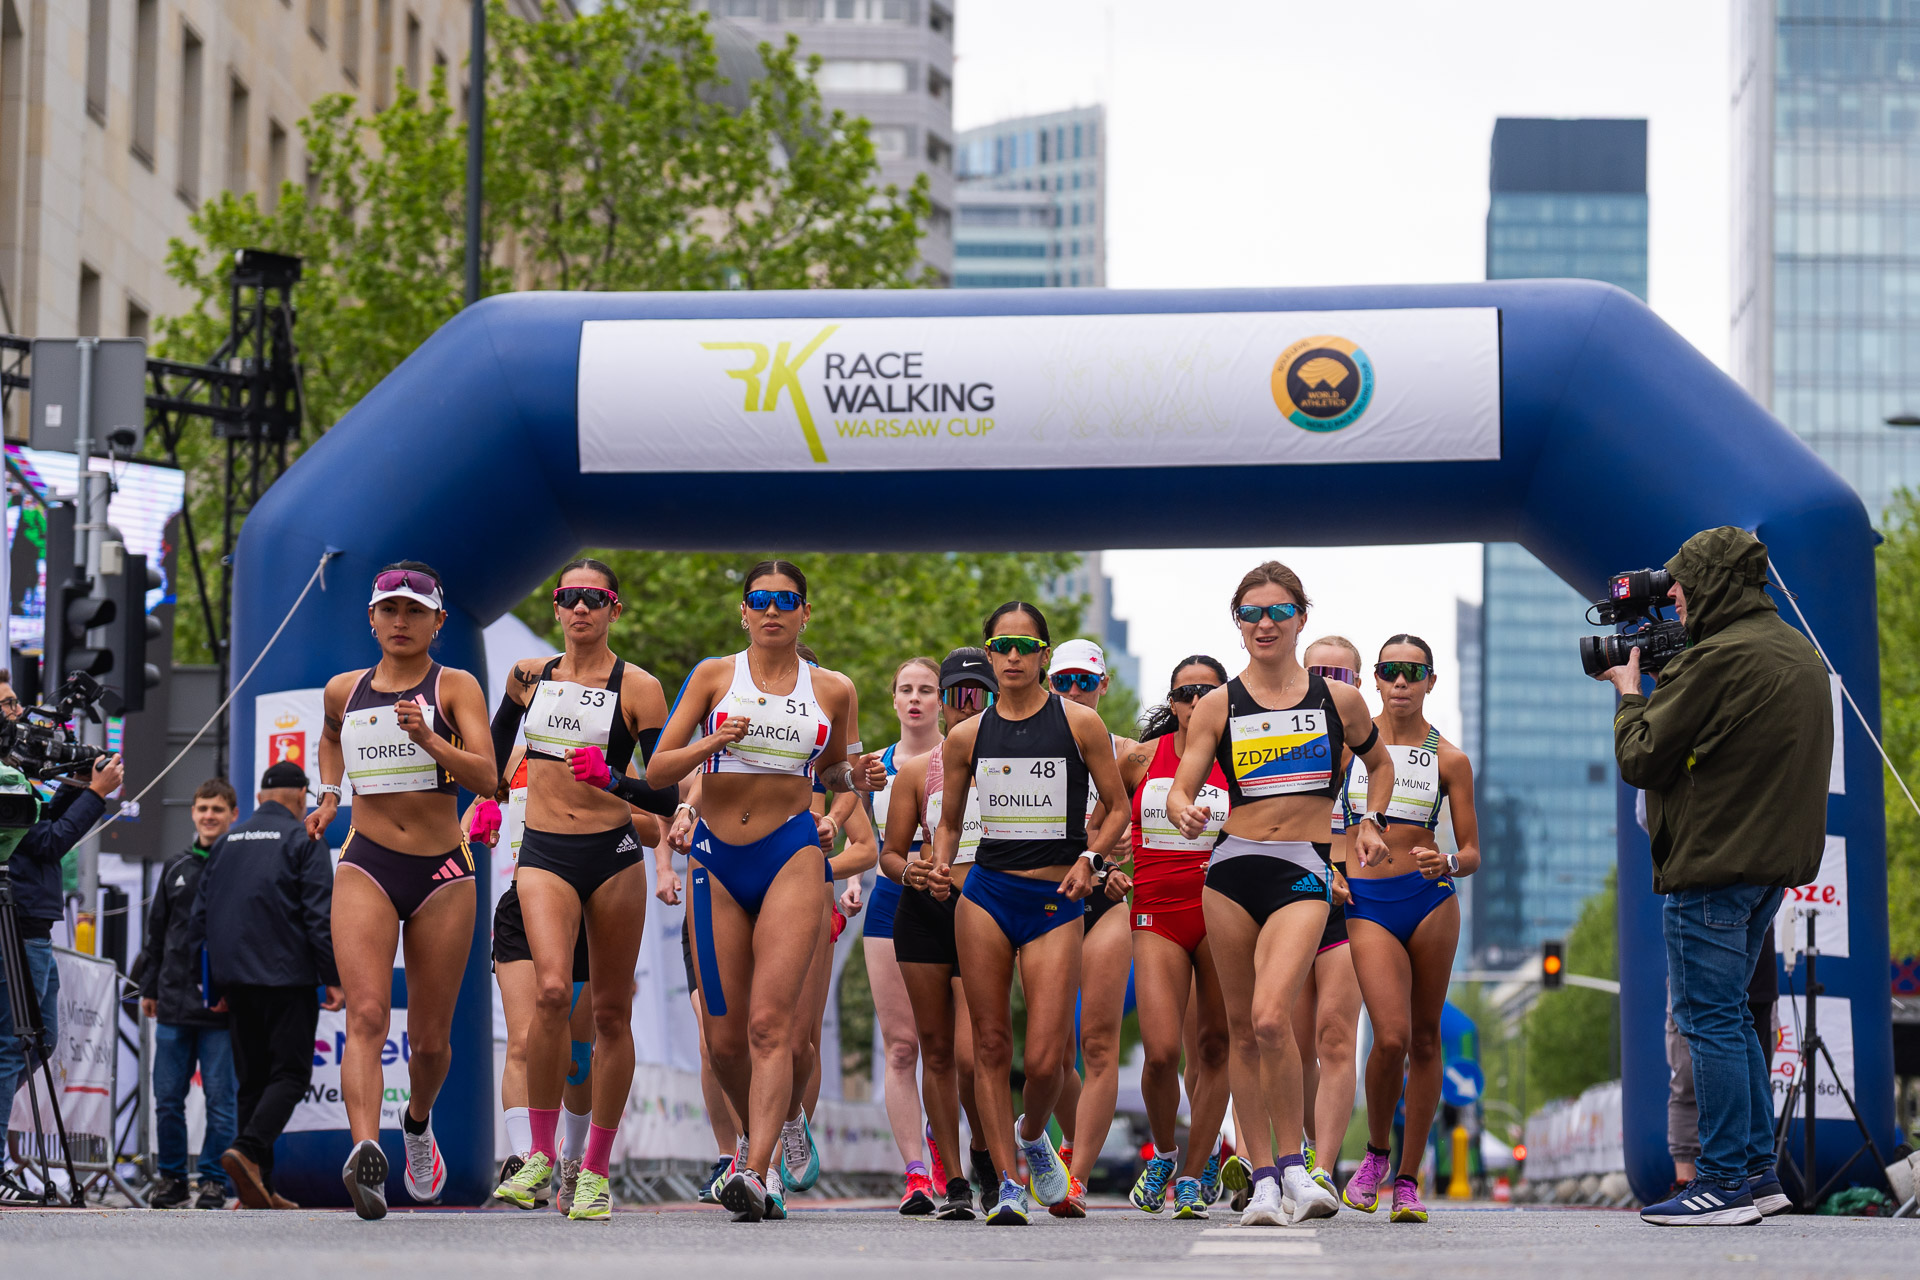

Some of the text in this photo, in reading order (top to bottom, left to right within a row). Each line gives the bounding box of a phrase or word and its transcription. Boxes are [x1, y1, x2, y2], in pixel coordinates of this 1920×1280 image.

[824, 352, 923, 379] RACE
[823, 382, 995, 413] WALKING
[1301, 399, 1347, 407] ATHLETICS
[1307, 391, 1339, 399] WORLD
[834, 418, 995, 438] WARSAW CUP
[580, 690, 606, 708] 53
[785, 698, 809, 717] 51
[548, 715, 581, 732] LYRA
[1291, 714, 1316, 732] 15
[747, 723, 800, 742] GARCÍA
[358, 743, 416, 760] TORRES
[1237, 744, 1327, 767] ZDZIEBŁO
[1408, 749, 1431, 767] 50
[1030, 761, 1056, 779] 48
[1197, 785, 1219, 799] 54
[1401, 778, 1431, 791] MUNIZ
[989, 794, 1053, 807] BONILLA
[1143, 808, 1167, 819] ORTU
[227, 830, 281, 842] new balance
[616, 843, 638, 853] adidas
[1291, 884, 1323, 893] adidas
